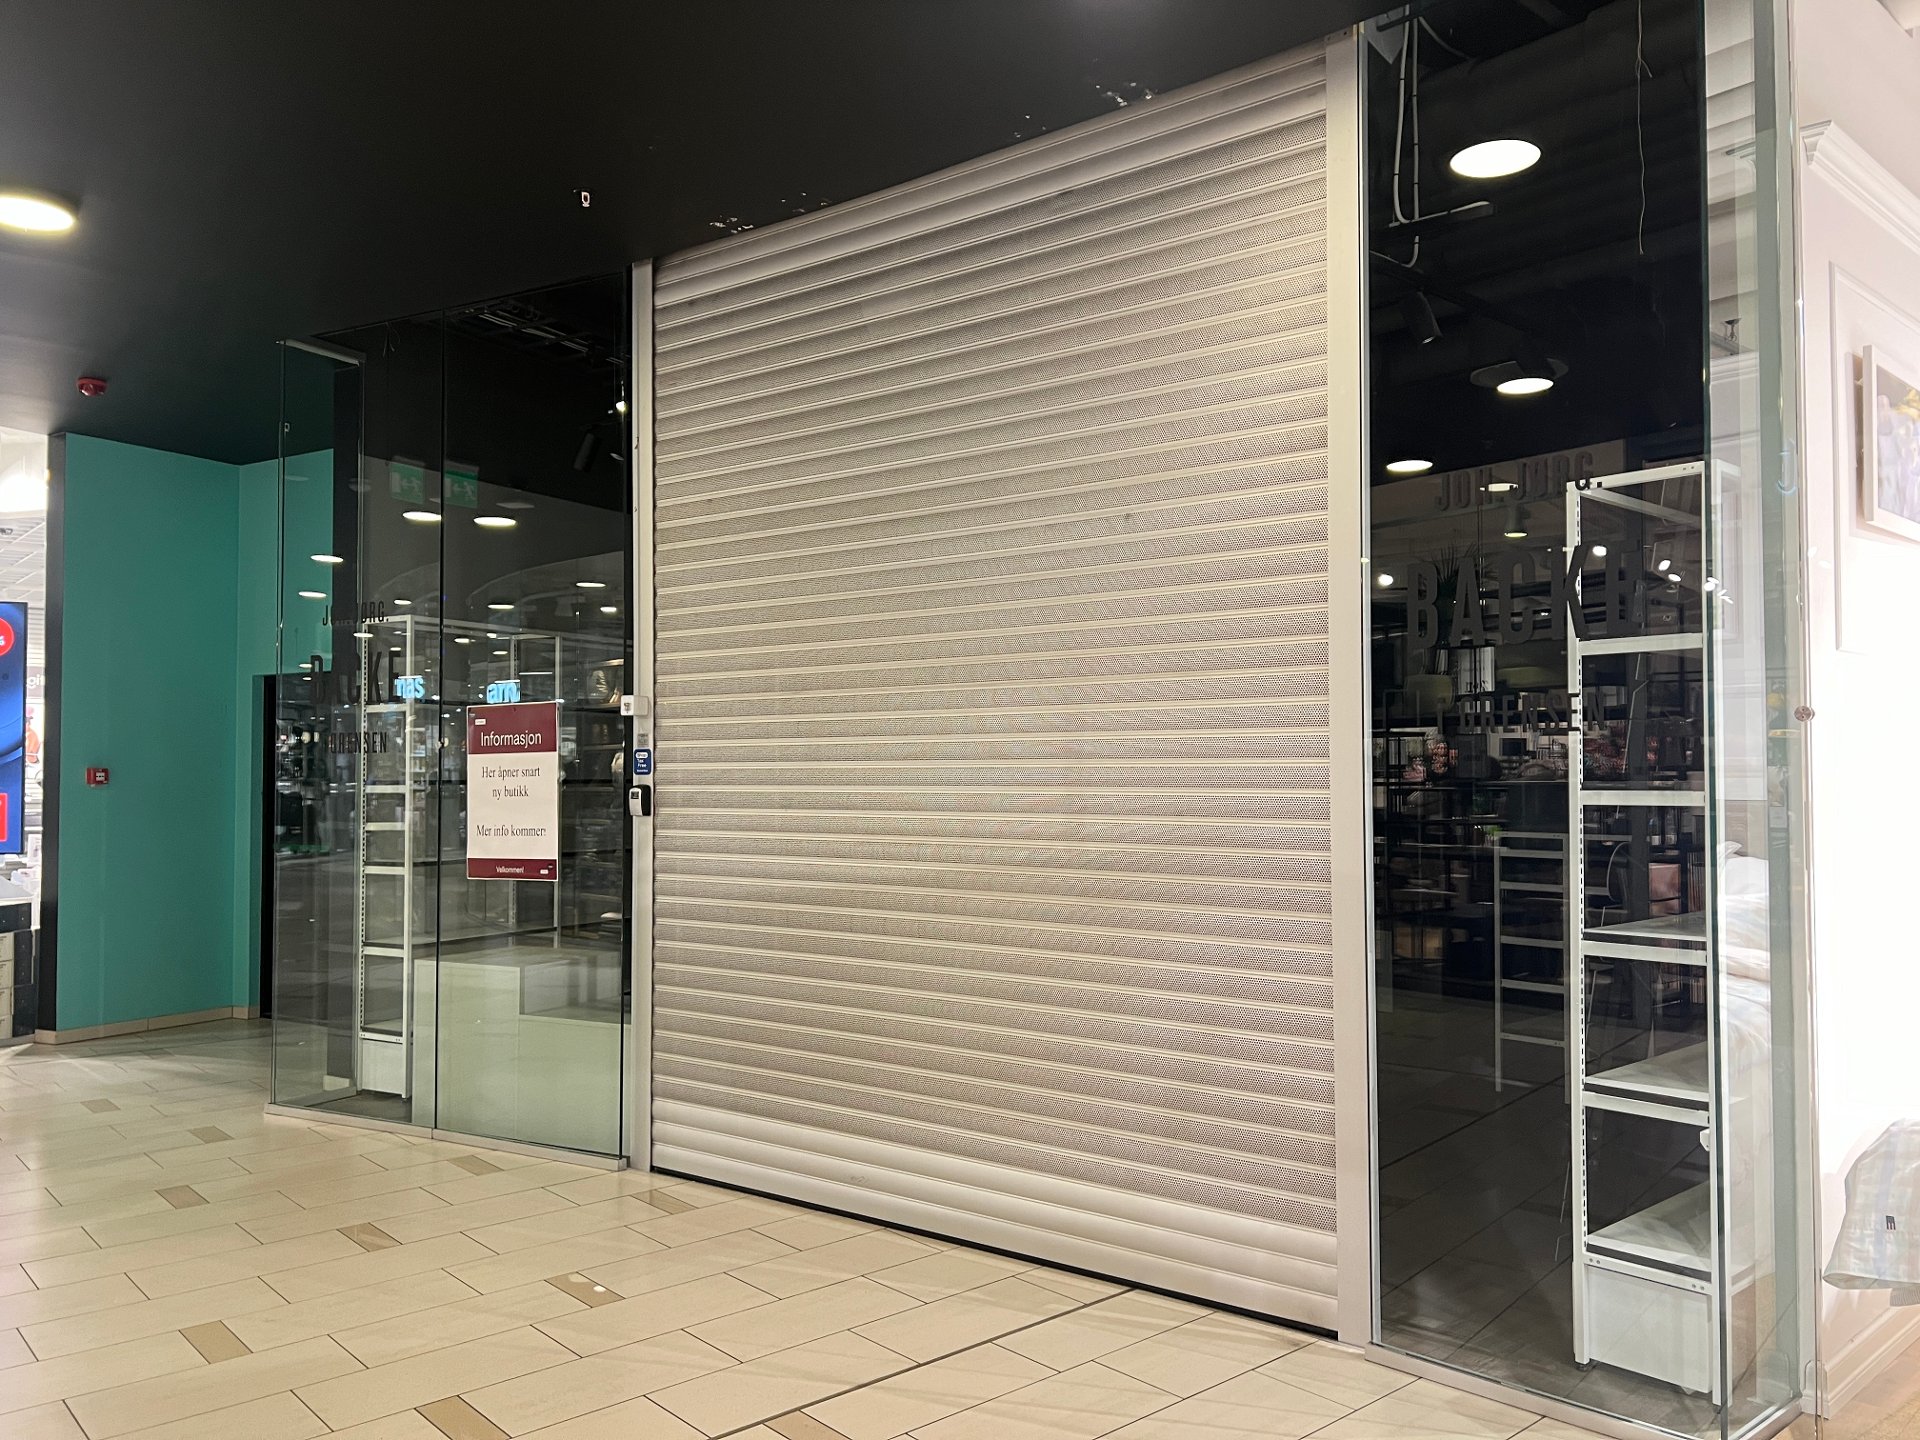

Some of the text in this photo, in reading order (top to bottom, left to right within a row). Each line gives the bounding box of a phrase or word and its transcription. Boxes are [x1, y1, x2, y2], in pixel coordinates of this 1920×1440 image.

[1407, 543, 1640, 649] BACKE
[480, 730, 542, 748] Informasjon
[481, 765, 540, 780] Her åpner snart
[492, 785, 529, 800] ny butikk
[476, 824, 492, 836] Mer
[493, 824, 509, 836] info
